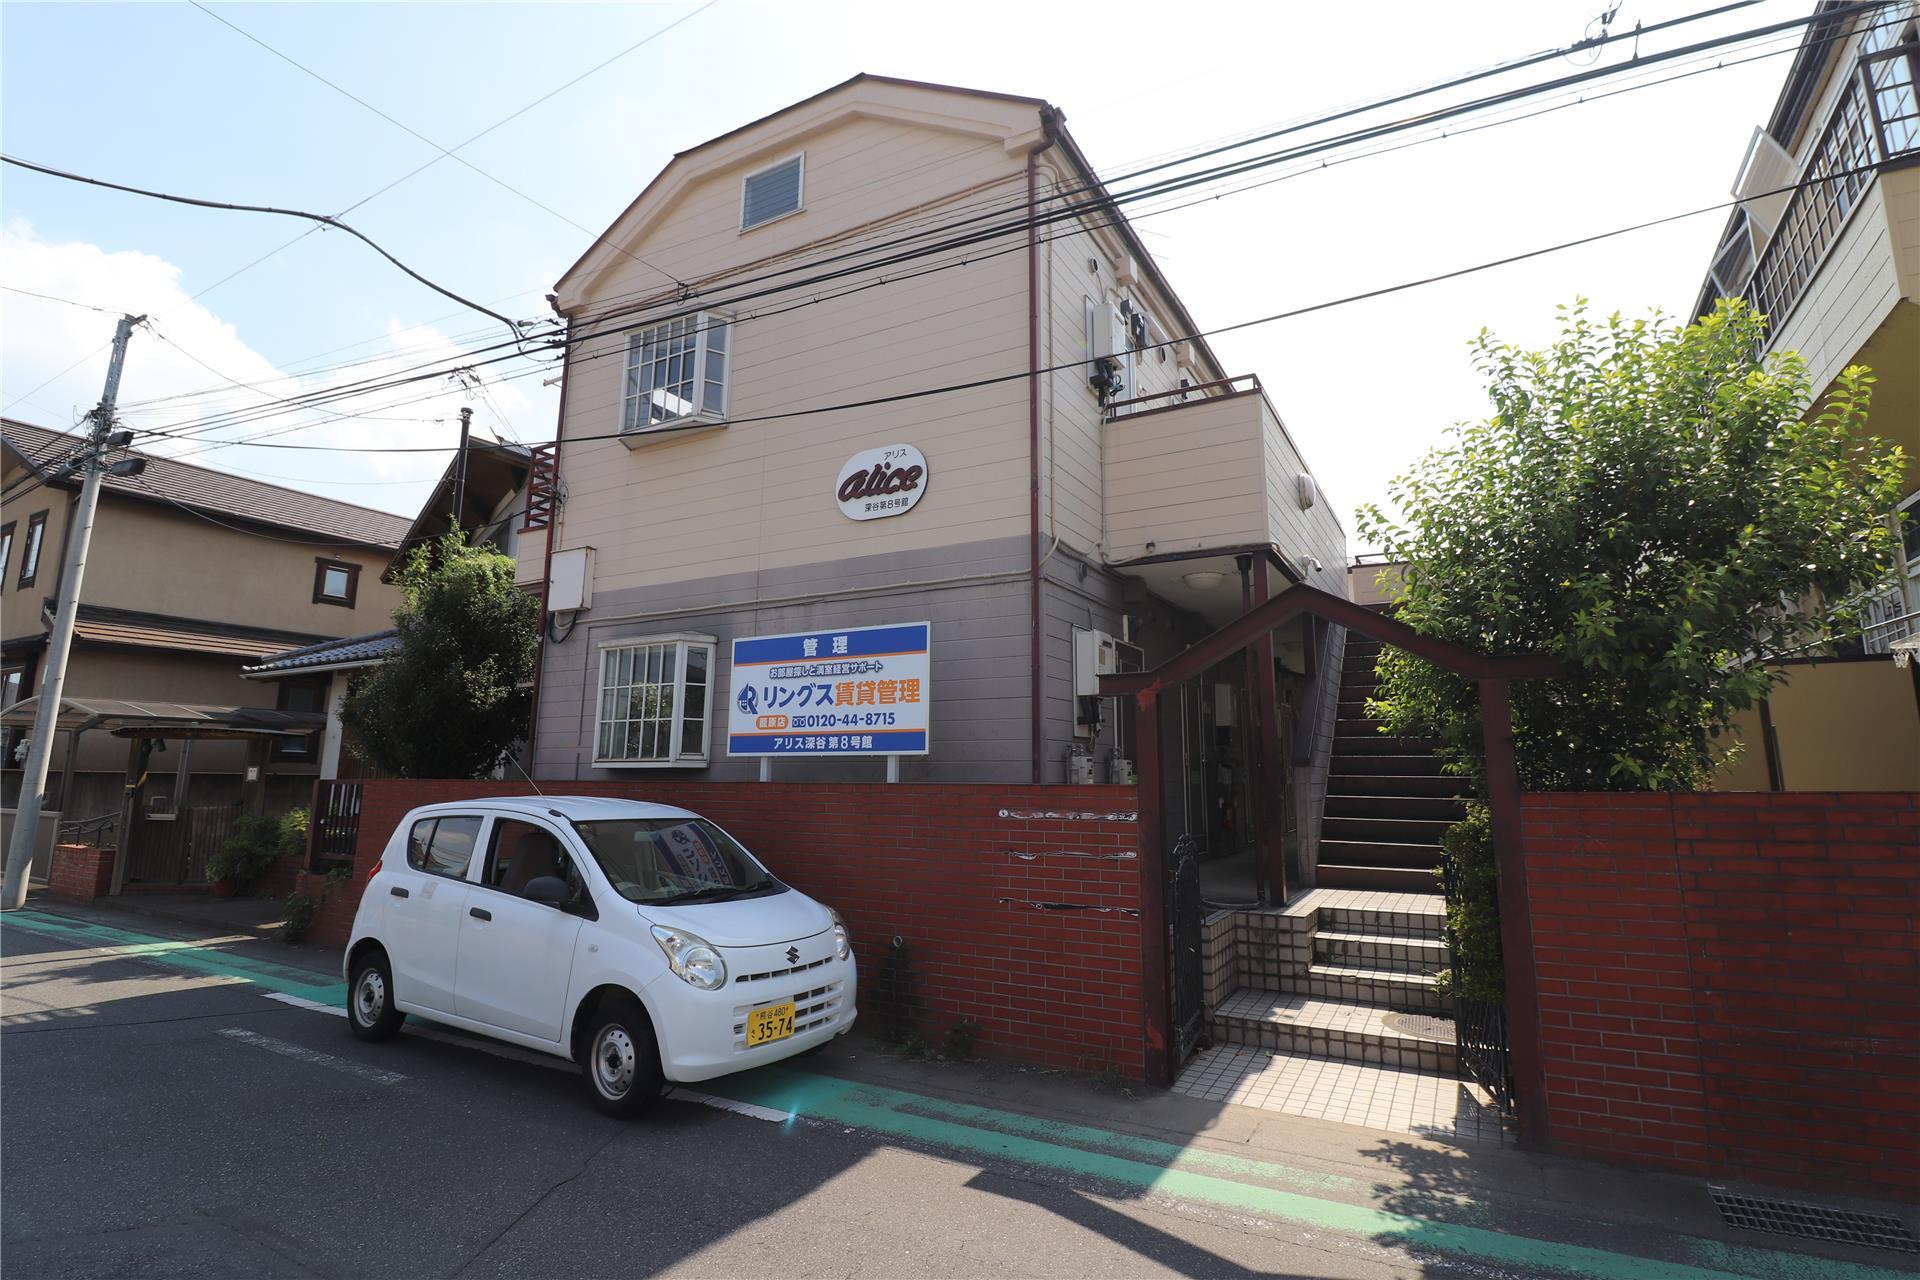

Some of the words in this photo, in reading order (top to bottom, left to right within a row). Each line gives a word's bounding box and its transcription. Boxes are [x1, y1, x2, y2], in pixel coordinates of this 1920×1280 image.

[884, 449, 907, 460] アリス
[838, 461, 923, 502] alice
[807, 712, 895, 728] 0120-44-8715
[758, 1016, 792, 1041] 35-74
